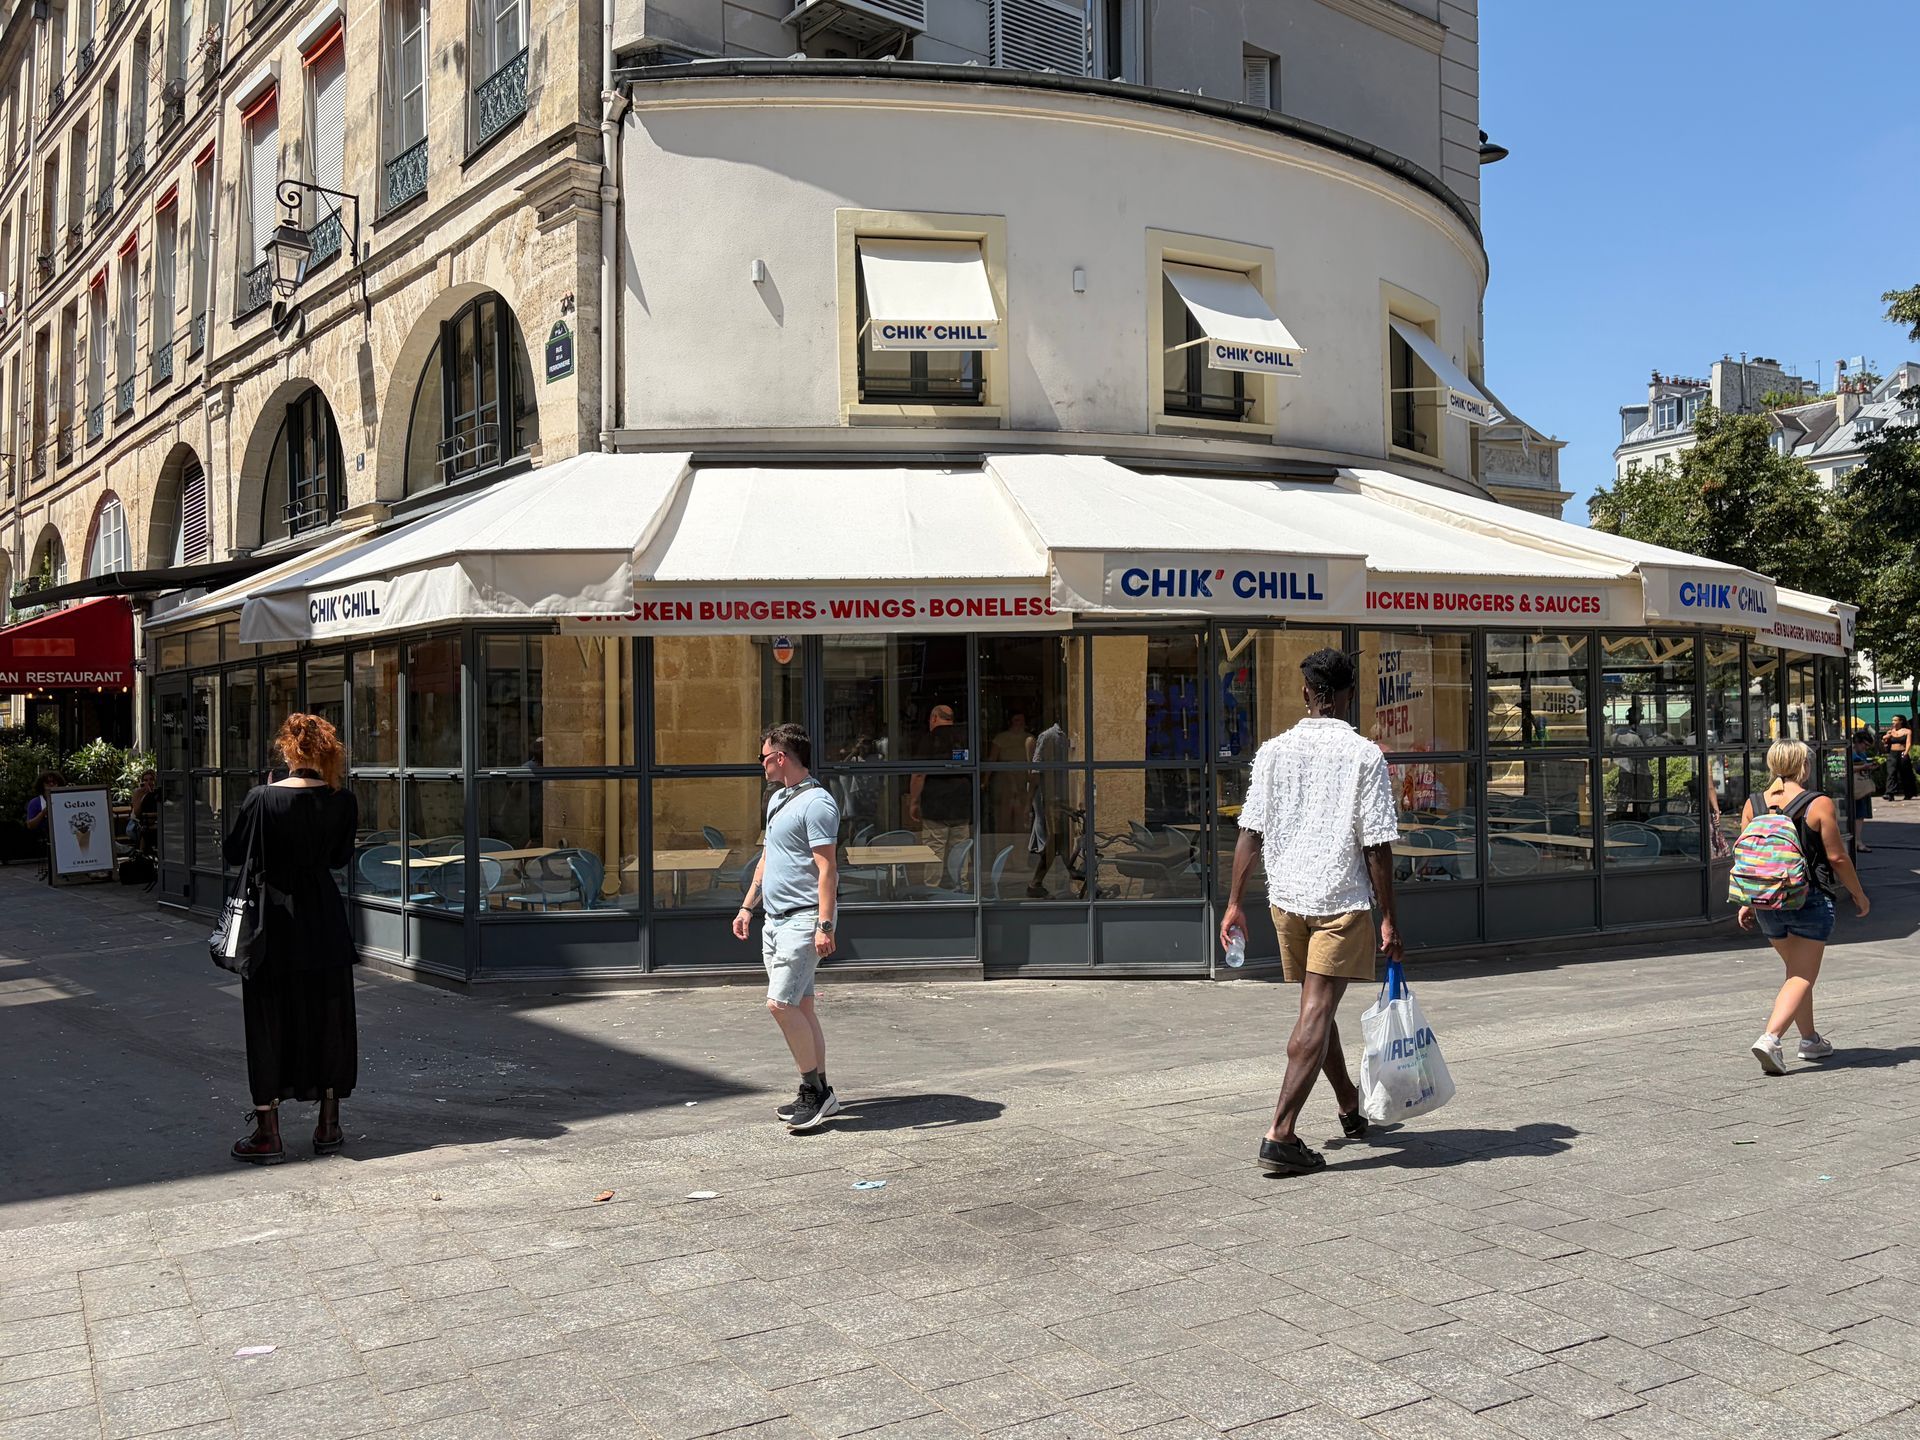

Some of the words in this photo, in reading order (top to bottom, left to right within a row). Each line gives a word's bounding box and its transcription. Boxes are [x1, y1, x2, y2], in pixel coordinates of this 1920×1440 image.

[700, 600, 817, 620] BURGERS
[829, 599, 916, 618] WINGS
[1433, 593, 1514, 612] BURGERS
[1519, 594, 1532, 612] &
[1535, 595, 1601, 613] SAUCES
[26, 671, 123, 683] RESTAURANT
[64, 800, 96, 809] Gelato
